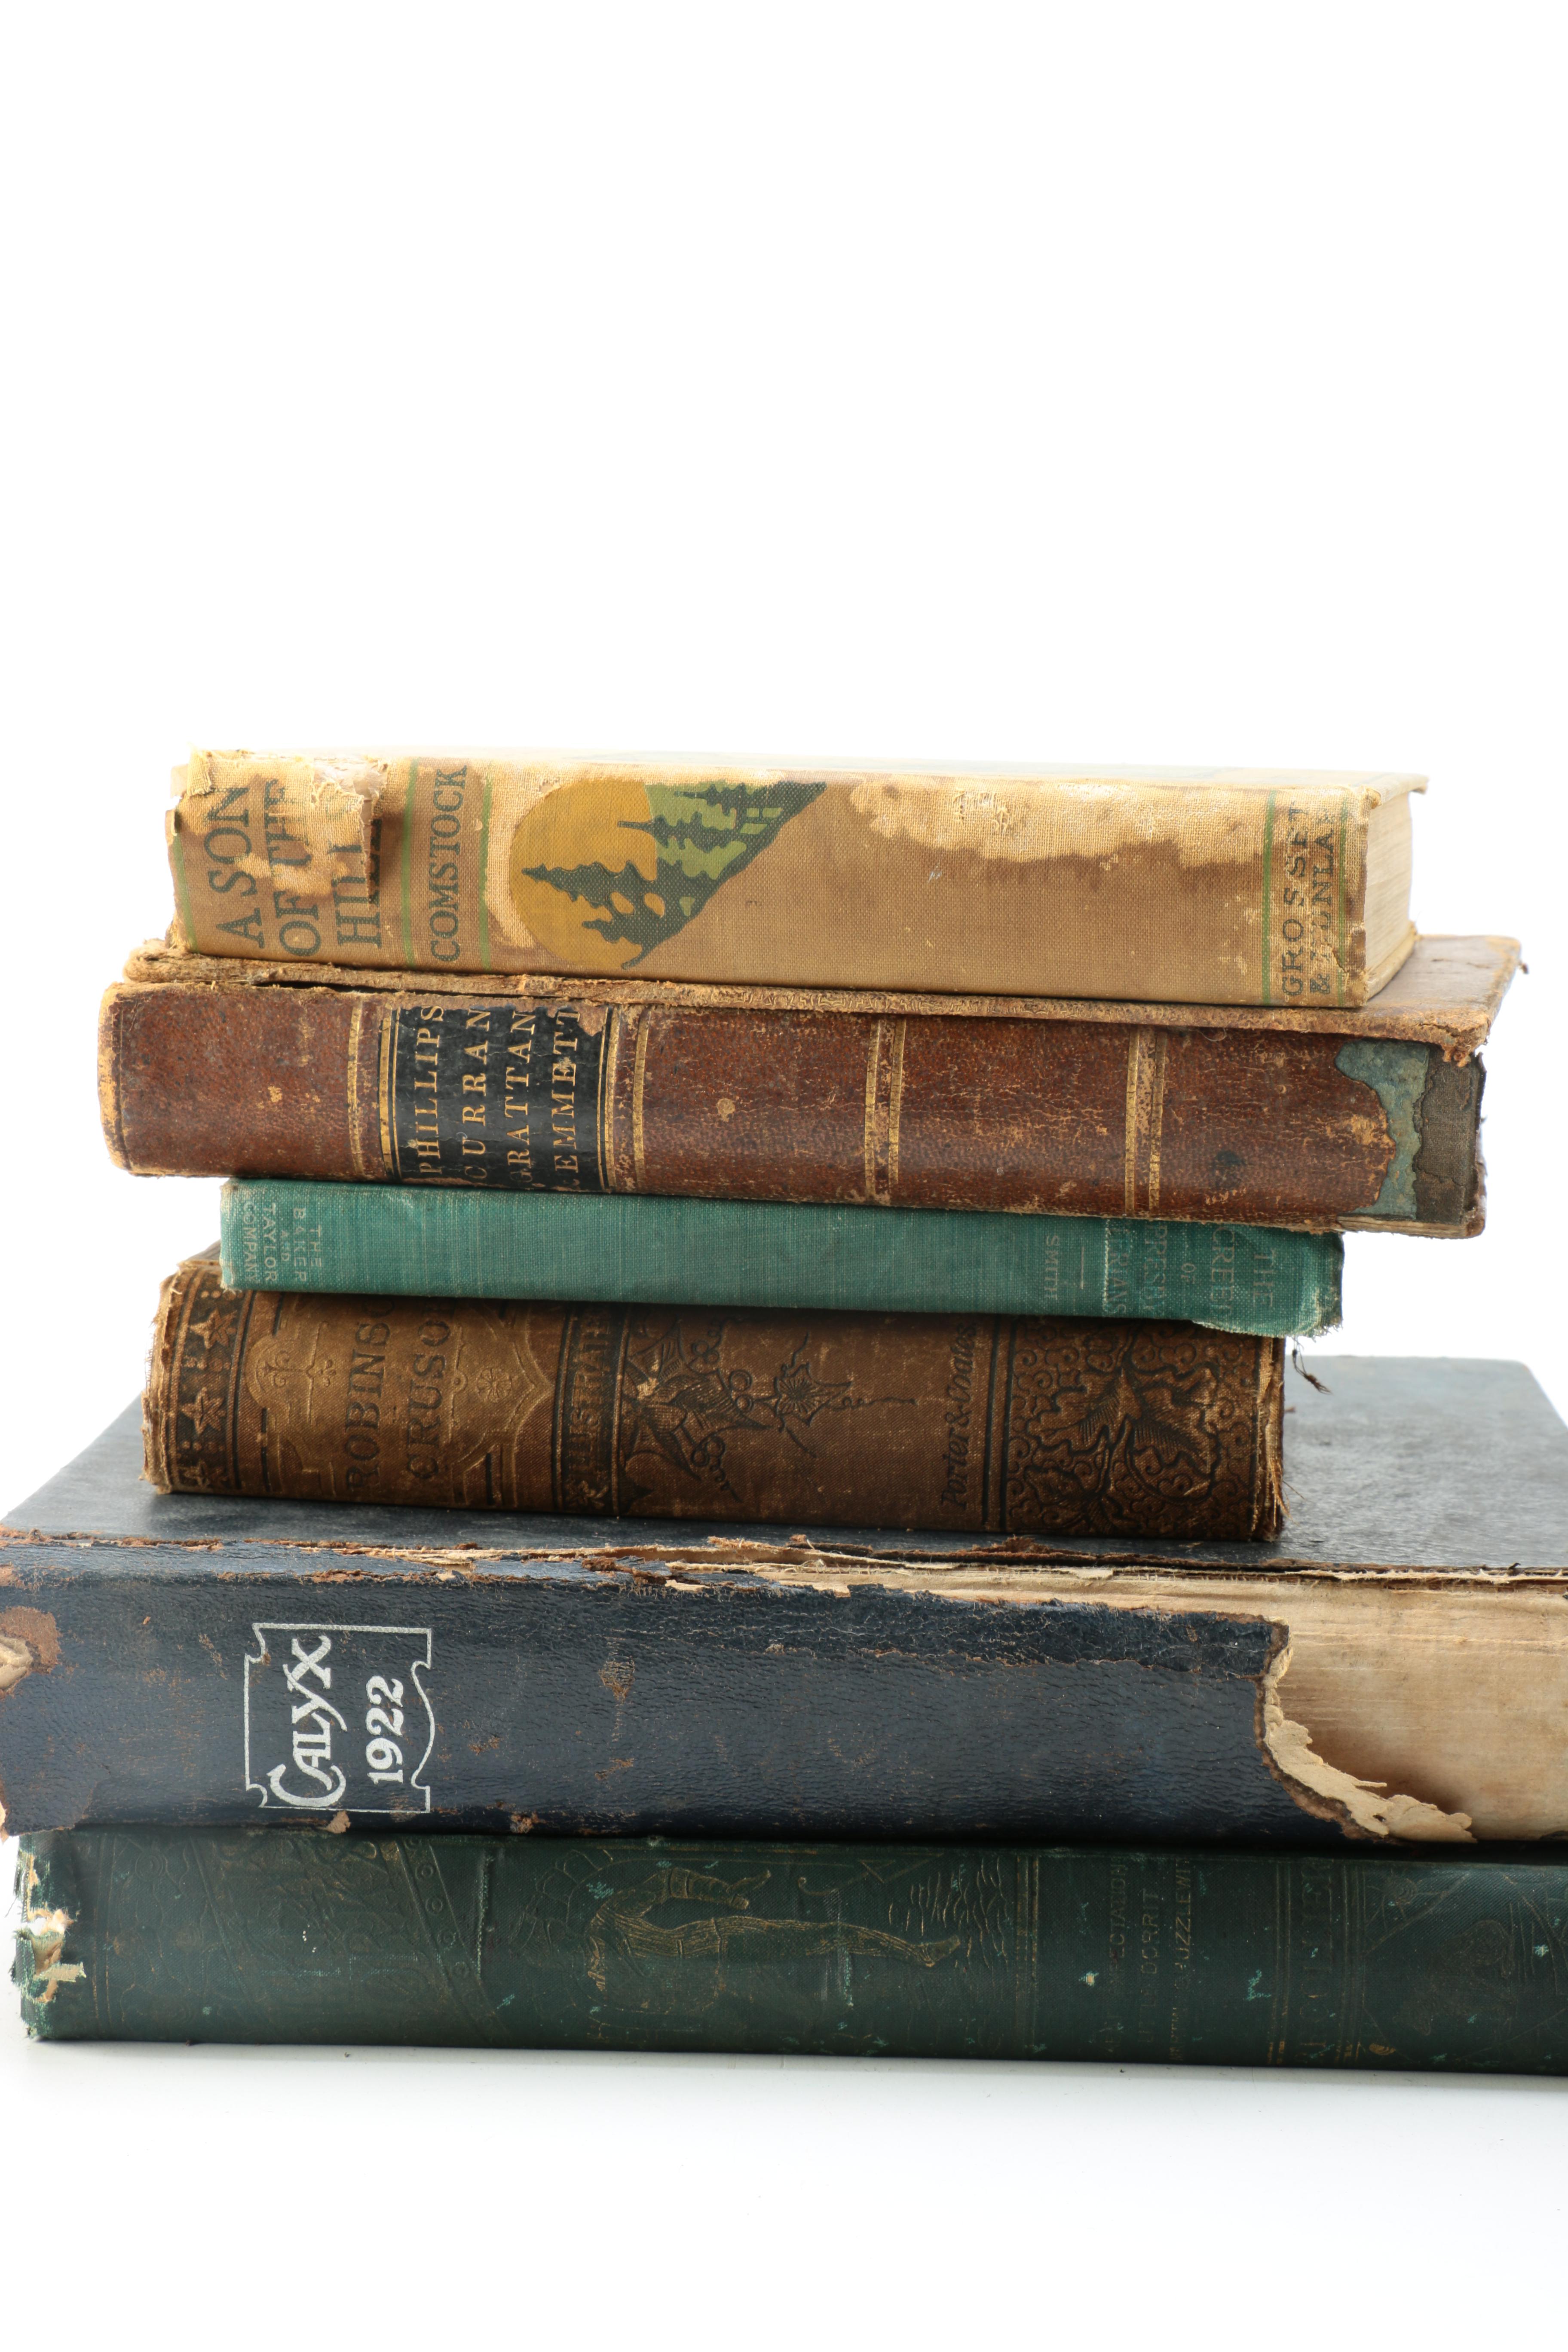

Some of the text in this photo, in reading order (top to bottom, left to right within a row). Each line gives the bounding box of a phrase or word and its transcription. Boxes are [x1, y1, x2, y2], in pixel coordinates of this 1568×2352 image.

[204, 787, 265, 949] A SON
[325, 795, 383, 947] HILL
[428, 765, 468, 962] COMSTOCK
[274, 891, 321, 957] OF
[1309, 973, 1331, 995] &
[414, 1005, 444, 1175] PHILLIPS
[462, 1008, 491, 1180] CURRAN
[504, 1010, 537, 1183] GRATTAN
[551, 1009, 580, 1173] EMMETT
[242, 1201, 260, 1282] COMPANY
[263, 1203, 277, 1281] TAYLOR
[280, 1230, 289, 1262] AND
[293, 1207, 307, 1282] BAKER
[309, 1225, 322, 1268] THE
[1044, 1234, 1060, 1301] SMITH
[1181, 1262, 1197, 1284] OF
[1253, 1247, 1276, 1308] THE
[941, 1428, 970, 1512] Porter
[266, 1635, 347, 1808] CALYX
[365, 1675, 404, 1785] 1922
[1141, 1888, 1159, 1974] DORRIT
